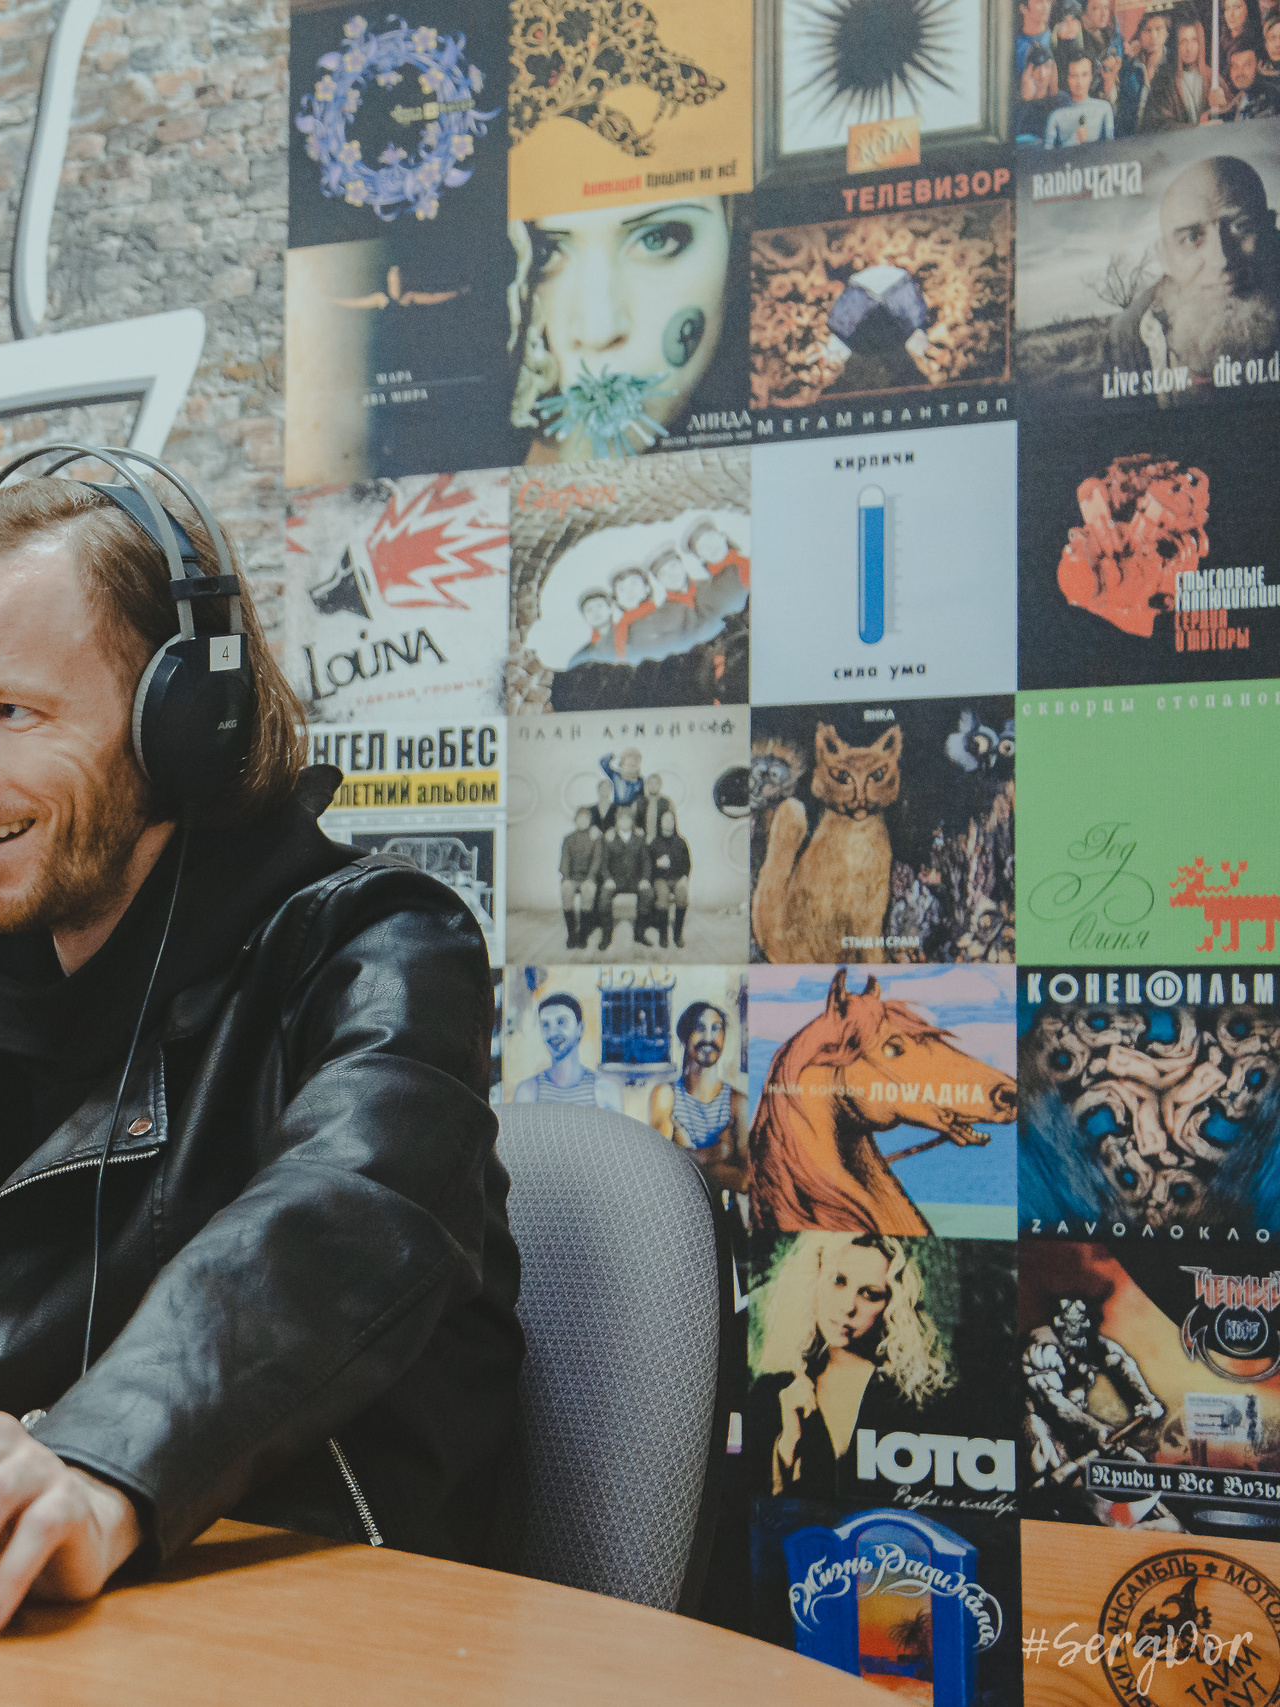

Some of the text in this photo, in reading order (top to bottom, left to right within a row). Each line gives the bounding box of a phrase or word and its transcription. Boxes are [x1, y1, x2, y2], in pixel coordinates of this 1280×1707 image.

[841, 167, 1011, 213] ТЕЛЕВИЗОР
[834, 451, 916, 473] кирпичи
[221, 644, 230, 662] 4
[833, 666, 878, 681] сила
[217, 719, 238, 731] AKG
[313, 731, 387, 772] НГЕЛ
[1223, 1475, 1280, 1499] Возь
[1224, 1564, 1280, 1634] МОТО
